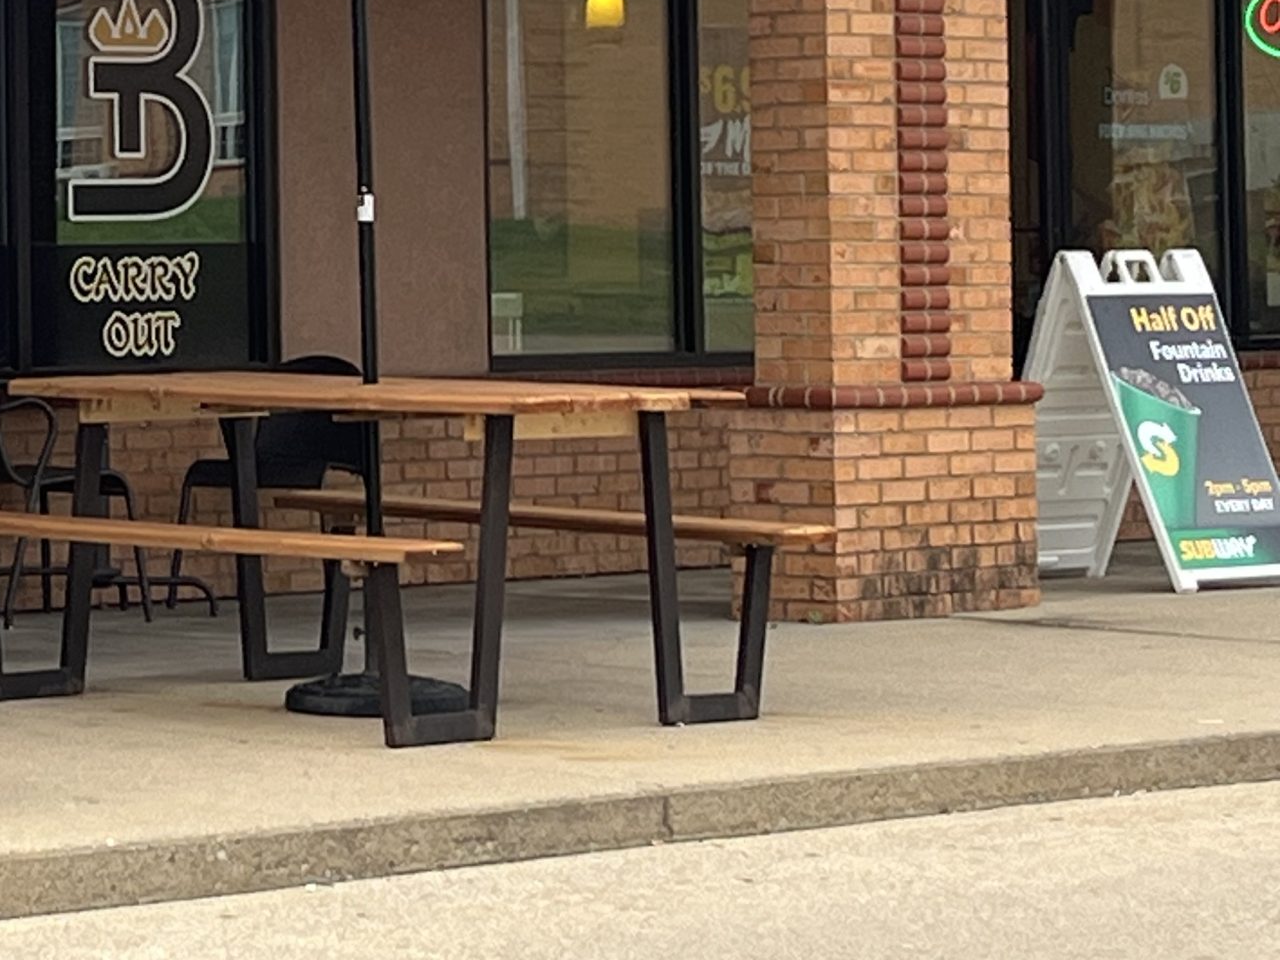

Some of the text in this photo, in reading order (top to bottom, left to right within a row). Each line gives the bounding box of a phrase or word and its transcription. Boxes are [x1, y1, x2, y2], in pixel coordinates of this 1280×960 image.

[70, 251, 199, 302] CARRY
[1130, 304, 1216, 332] Half Off
[102, 311, 180, 357] OUT
[1149, 339, 1228, 360] Fountain
[1176, 362, 1235, 383] Drinks
[1179, 536, 1255, 561] SUBWAY
